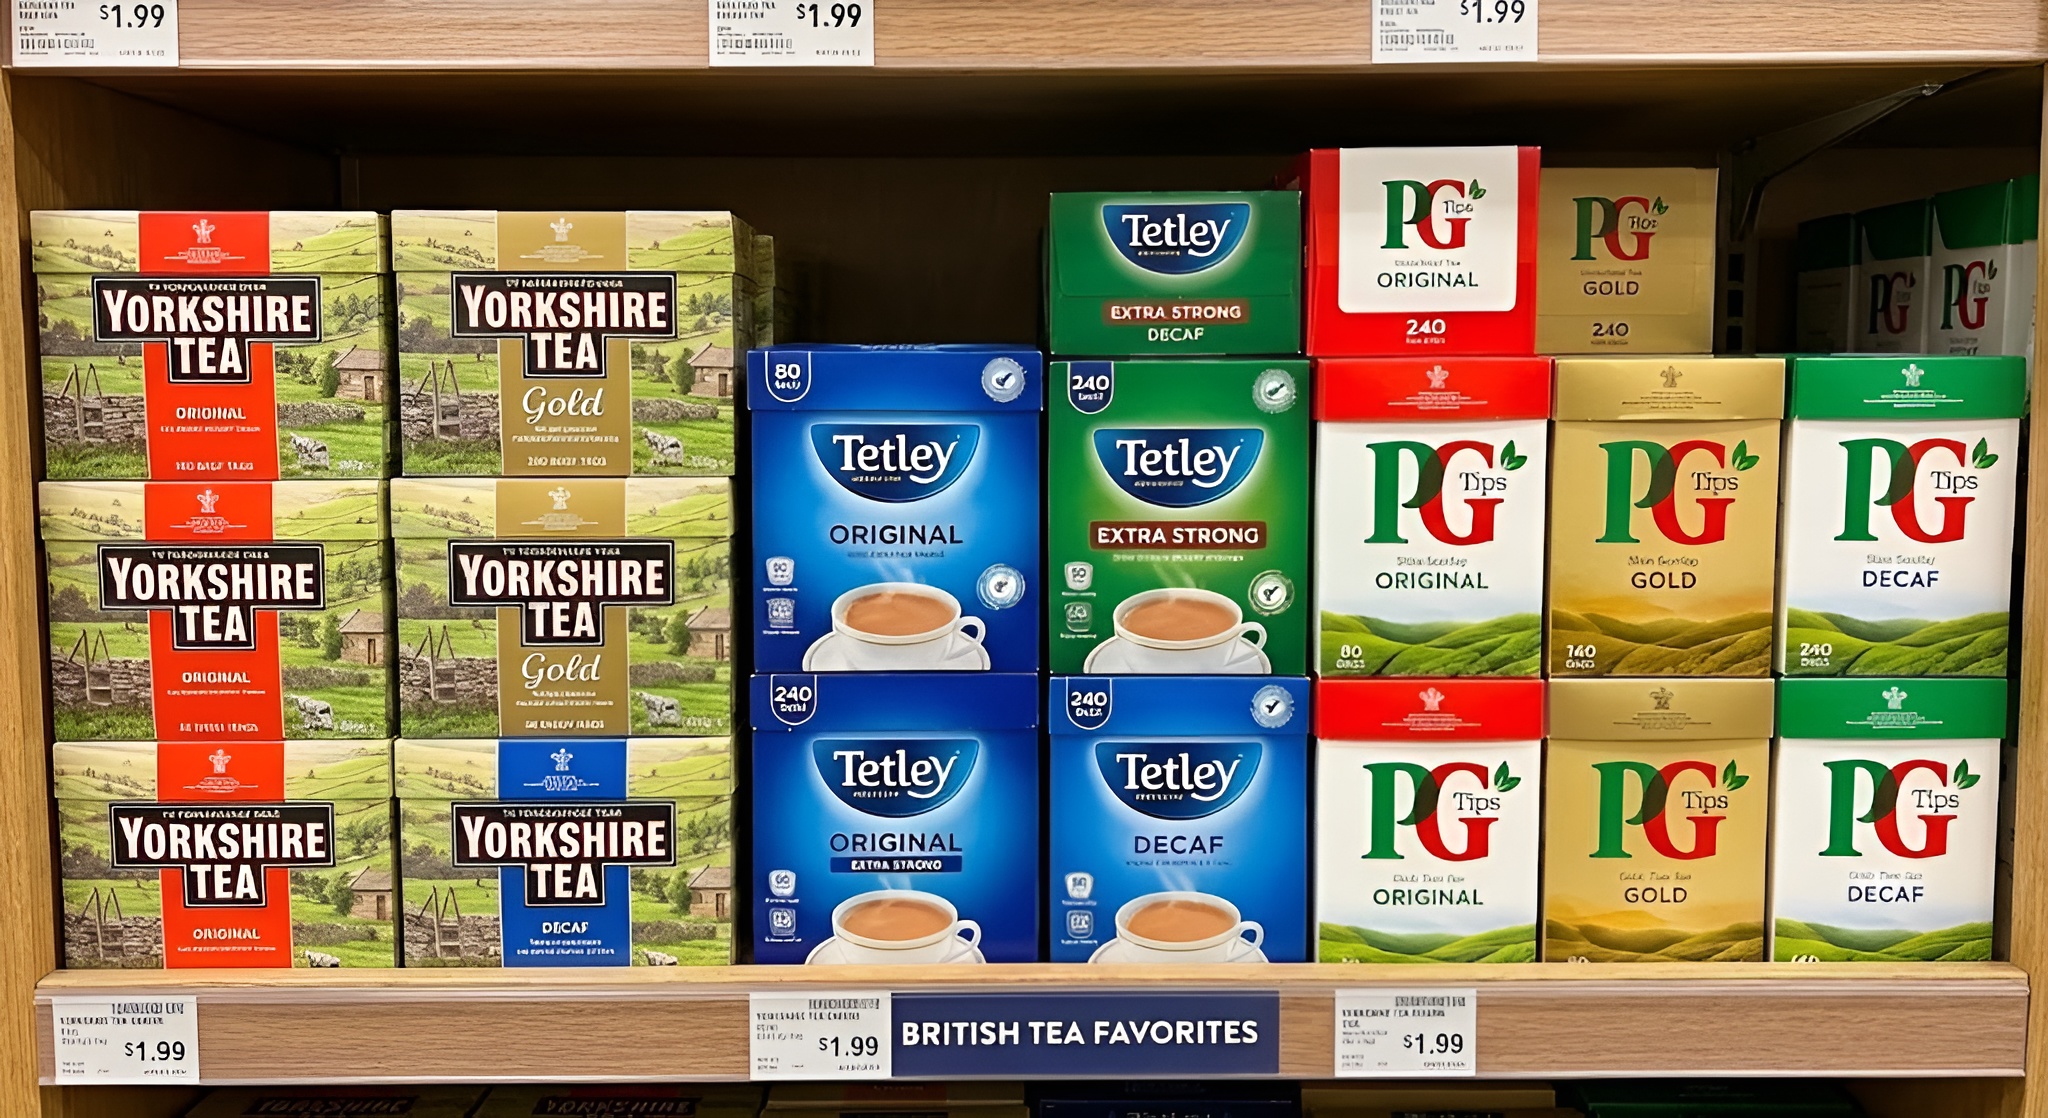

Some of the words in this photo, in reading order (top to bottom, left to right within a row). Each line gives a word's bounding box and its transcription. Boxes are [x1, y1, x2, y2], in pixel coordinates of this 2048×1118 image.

[99, 4, 165, 28] $1.99
[796, 3, 862, 28] $1.99
[1460, 0, 1525, 23] $1.99
[1380, 178, 1472, 250] PG
[1570, 196, 1657, 262] PG
[1121, 213, 1231, 257] Tetley
[1376, 271, 1479, 288] ORIGINAL
[1583, 281, 1640, 296] GOLD
[1939, 260, 1989, 330] PG
[102, 289, 311, 333] YORKSHIRE
[460, 284, 666, 328] YORKSHIRE
[1171, 305, 1242, 319] STRONG
[1406, 318, 1447, 335] 240
[174, 337, 243, 373] TEA
[530, 332, 598, 369] TEA
[774, 363, 801, 379] 80
[1071, 375, 1110, 391] 240
[521, 386, 605, 424] Gold
[832, 434, 960, 484] Tetley
[1115, 438, 1241, 488] Tetley
[1363, 440, 1505, 546] PG
[1459, 471, 1507, 496] Tips
[1595, 439, 1736, 546] PG
[1691, 471, 1739, 496] Tips
[1833, 437, 1976, 544] PG
[1930, 470, 1978, 494] Tips
[829, 524, 963, 545] ORIGINAL
[1097, 527, 1167, 544] EXTRA
[1172, 527, 1259, 544] STRONG
[107, 557, 315, 600] YORKSHIRE
[458, 554, 664, 597] YORKSHIRE
[1375, 571, 1489, 590] ORIGINAL
[1631, 571, 1697, 590] GOLD
[1862, 570, 1940, 588] DECAF
[179, 605, 247, 642] TEA
[528, 602, 596, 637] TEA
[521, 652, 601, 690] Gold
[774, 686, 812, 702] 240
[1070, 691, 1108, 707] 240
[833, 749, 959, 799] Tetley
[1115, 752, 1241, 802] Tetley
[1361, 761, 1499, 862] PG
[1453, 791, 1501, 816] Tips
[1588, 760, 1727, 861] PG
[1681, 790, 1729, 814] Tips
[1818, 759, 1958, 859] PG
[1911, 789, 1960, 813] Tips
[119, 816, 326, 860] YORKSHIRE
[460, 815, 666, 858] YORKSHIRE
[829, 833, 963, 852] ORIGINAL
[1134, 836, 1224, 855] DECAF
[190, 864, 258, 899] TEA
[530, 863, 598, 898] TEA
[1373, 888, 1484, 906] ORIGINAL
[1624, 887, 1688, 904] GOLD
[1847, 885, 1925, 903] DECAF
[818, 1036, 879, 1057] $1.99
[902, 1021, 1020, 1046] BRITISH
[1029, 1021, 1086, 1045] TEA
[1093, 1020, 1259, 1045] FAVORITES
[1403, 1033, 1464, 1054] $1.99
[124, 1041, 186, 1062] $1.99
